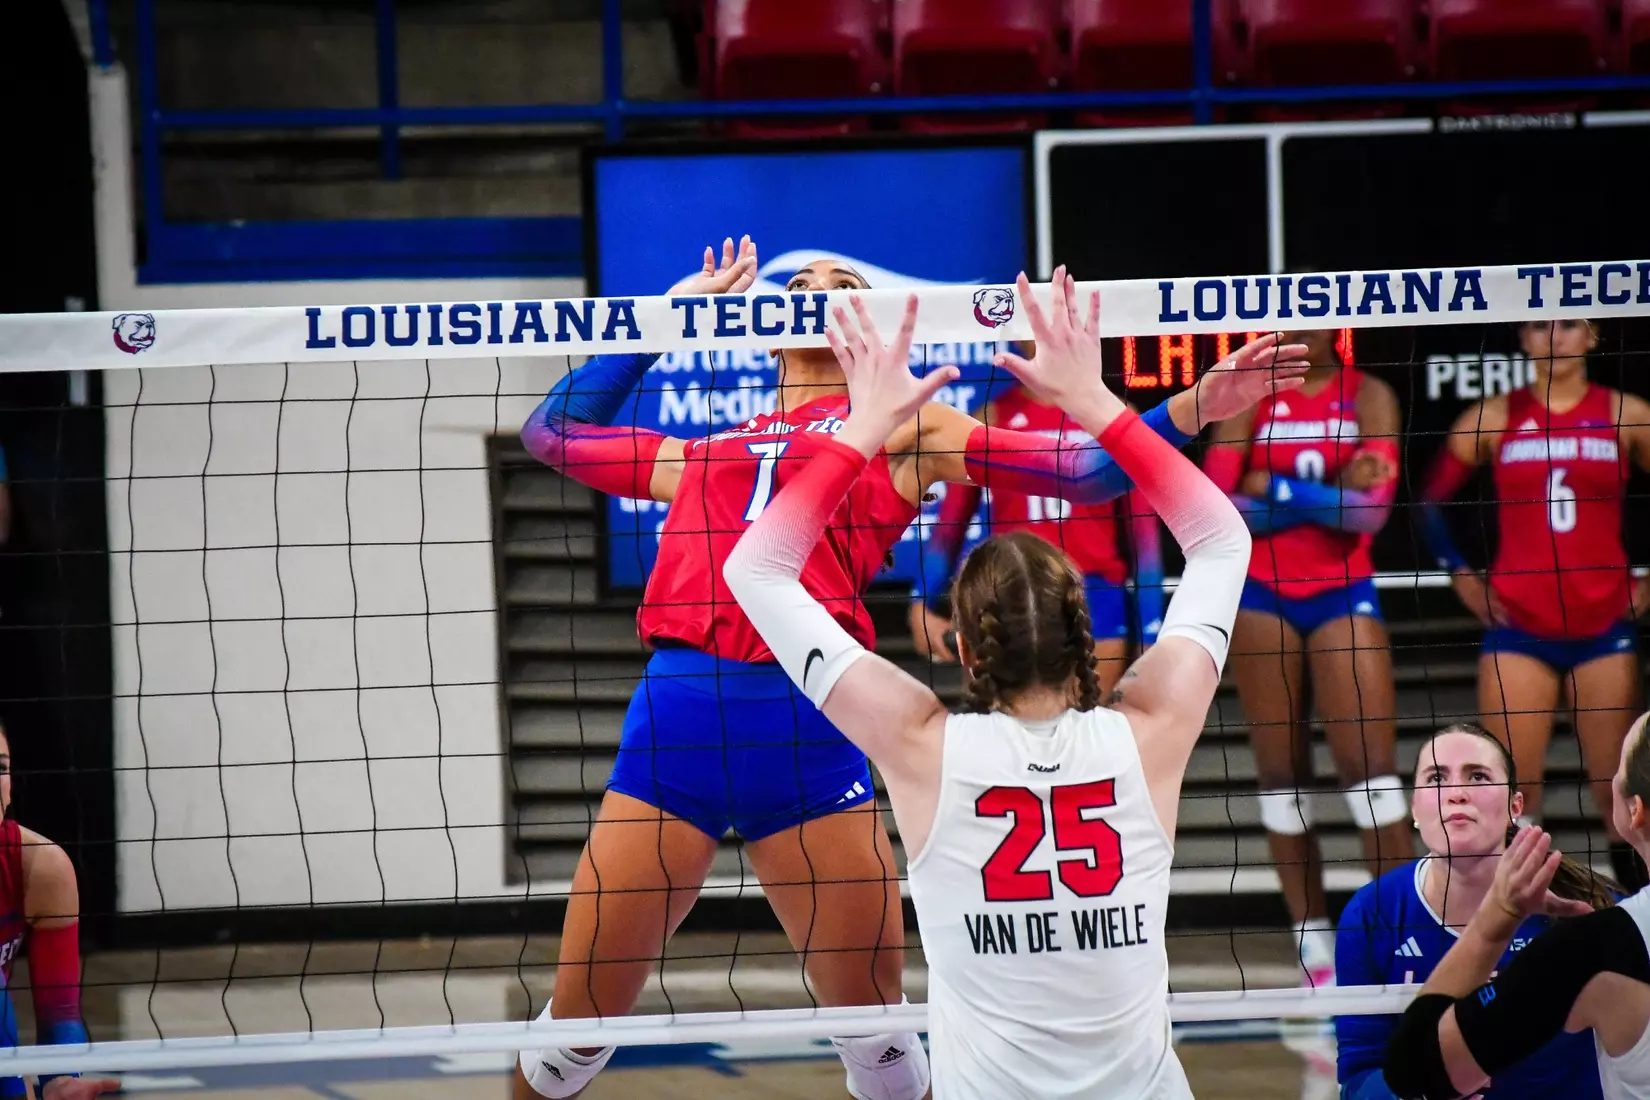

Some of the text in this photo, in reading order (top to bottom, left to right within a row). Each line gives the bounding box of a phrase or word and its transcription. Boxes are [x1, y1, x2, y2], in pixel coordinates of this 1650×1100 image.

[305, 293, 828, 349] LOUISIANA TECH
[1158, 269, 1489, 322] LOUISIANA
[743, 440, 791, 523] 7
[1547, 467, 1577, 533] 6
[975, 778, 1124, 902] 25
[964, 904, 1148, 954] VAN DE WIELE
